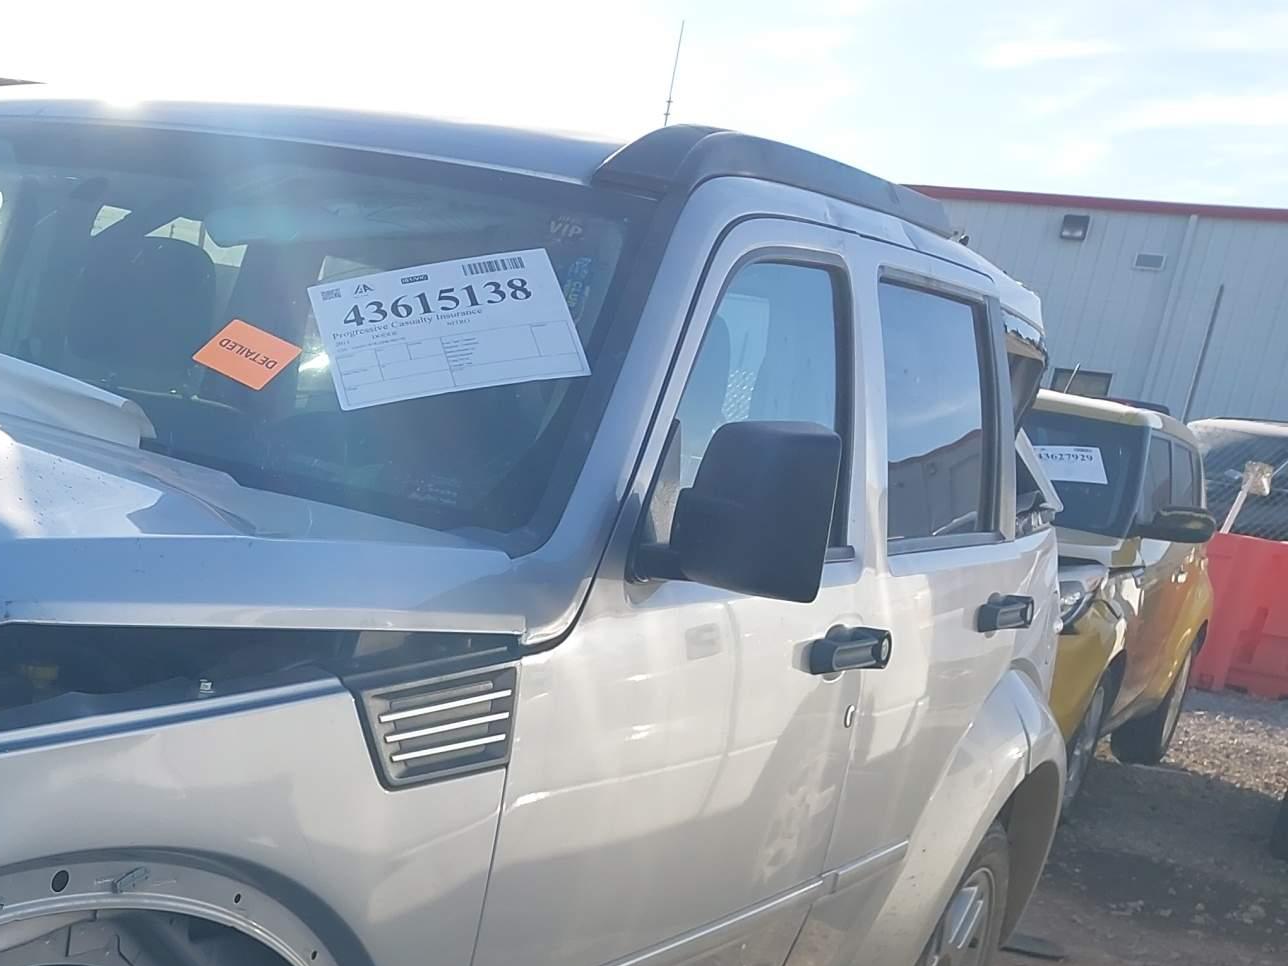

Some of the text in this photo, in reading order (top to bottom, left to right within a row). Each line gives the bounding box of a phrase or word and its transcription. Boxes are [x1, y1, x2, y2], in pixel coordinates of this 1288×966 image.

[550, 220, 583, 237] VIP
[343, 277, 532, 327] 43615138
[332, 308, 483, 340] Progressive Casualty Insurance
[219, 338, 278, 370] DETAILED
